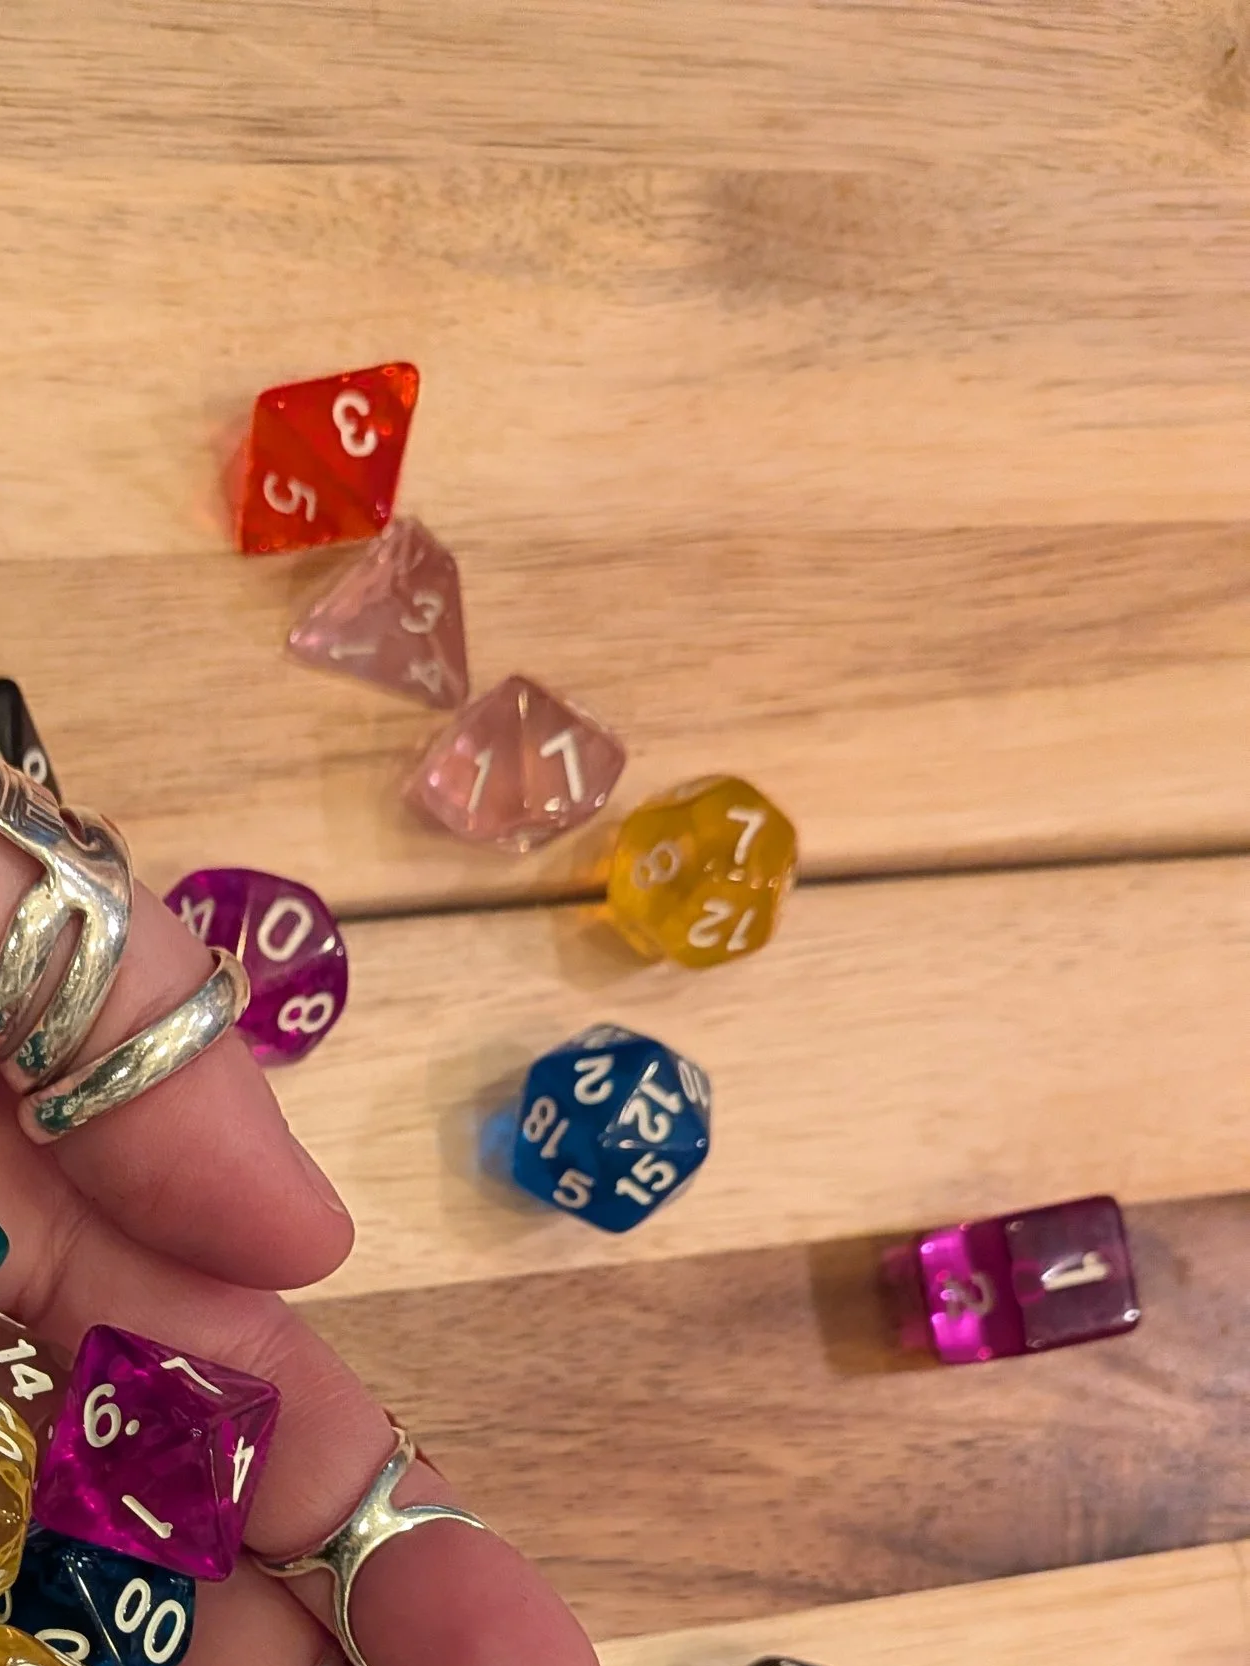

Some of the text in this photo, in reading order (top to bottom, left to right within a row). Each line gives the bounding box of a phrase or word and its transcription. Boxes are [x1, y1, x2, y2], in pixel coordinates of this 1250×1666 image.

[333, 390, 378, 457] 3
[264, 471, 317, 522] 5
[400, 592, 445, 634] 3
[468, 749, 494, 812] 1
[540, 731, 582, 803] 7
[726, 807, 768, 865] 7
[632, 841, 681, 890] 8
[257, 897, 314, 962] 0
[686, 897, 757, 952] 12
[277, 991, 335, 1033] 8
[573, 1054, 615, 1105] 2
[522, 1095, 571, 1159] 18
[618, 1078, 683, 1143] 12
[552, 1168, 595, 1209] 5
[614, 1151, 678, 1206] 15
[1042, 1251, 1108, 1291] 1
[232, 1436, 255, 1504] 4
[121, 1494, 174, 1539] 1
[115, 1578, 186, 1665] 00
